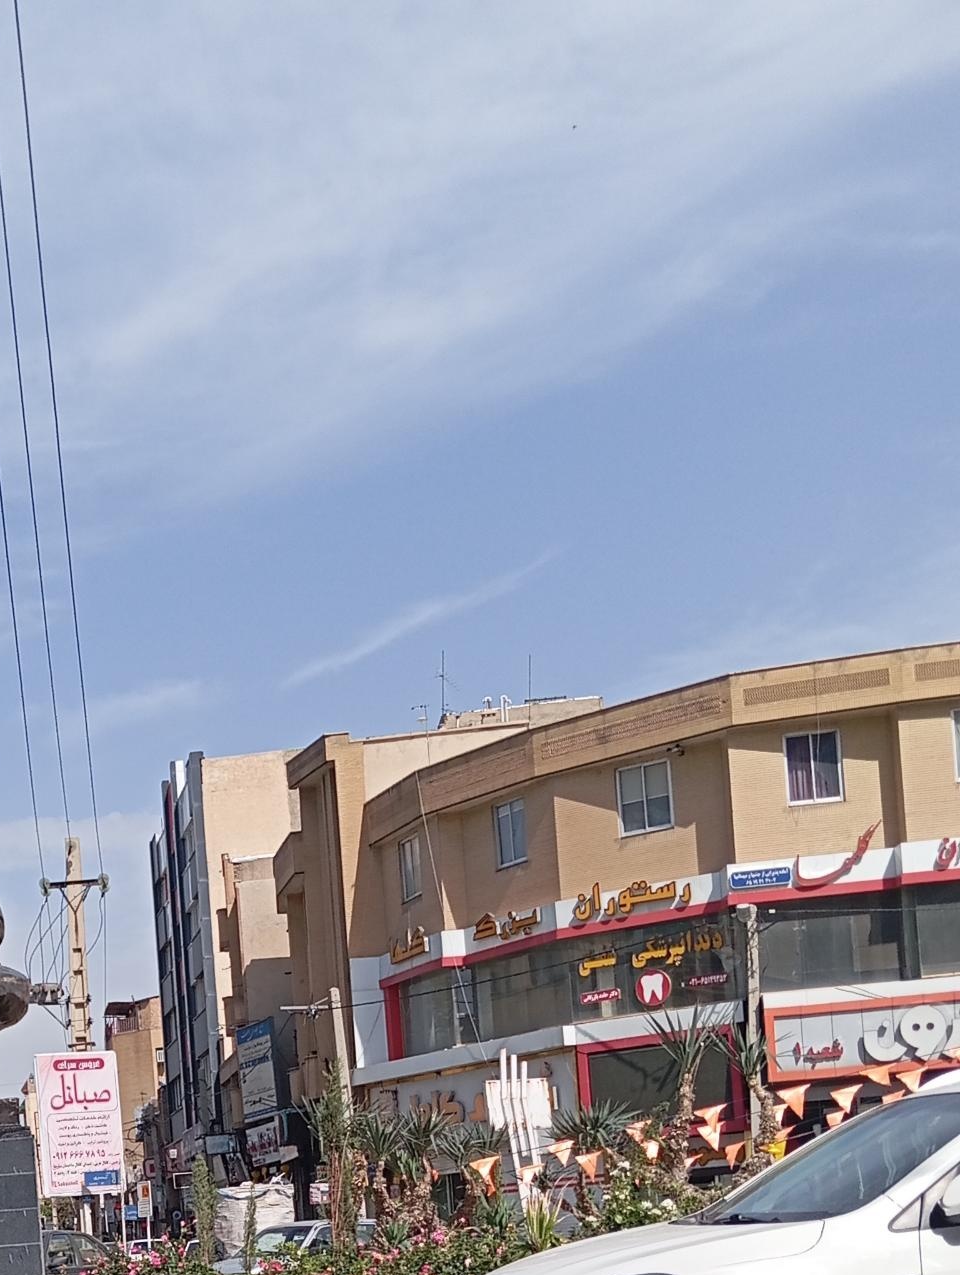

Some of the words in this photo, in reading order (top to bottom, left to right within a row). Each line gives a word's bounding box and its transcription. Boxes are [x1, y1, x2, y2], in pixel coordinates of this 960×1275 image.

[574, 879, 692, 921] رستوران
[473, 906, 541, 942] بزرگ
[631, 929, 724, 969] دندانپزشکی
[608, 990, 618, 998] دکتر
[78, 1060, 100, 1070] عروس
[50, 1073, 111, 1110] صبانل
